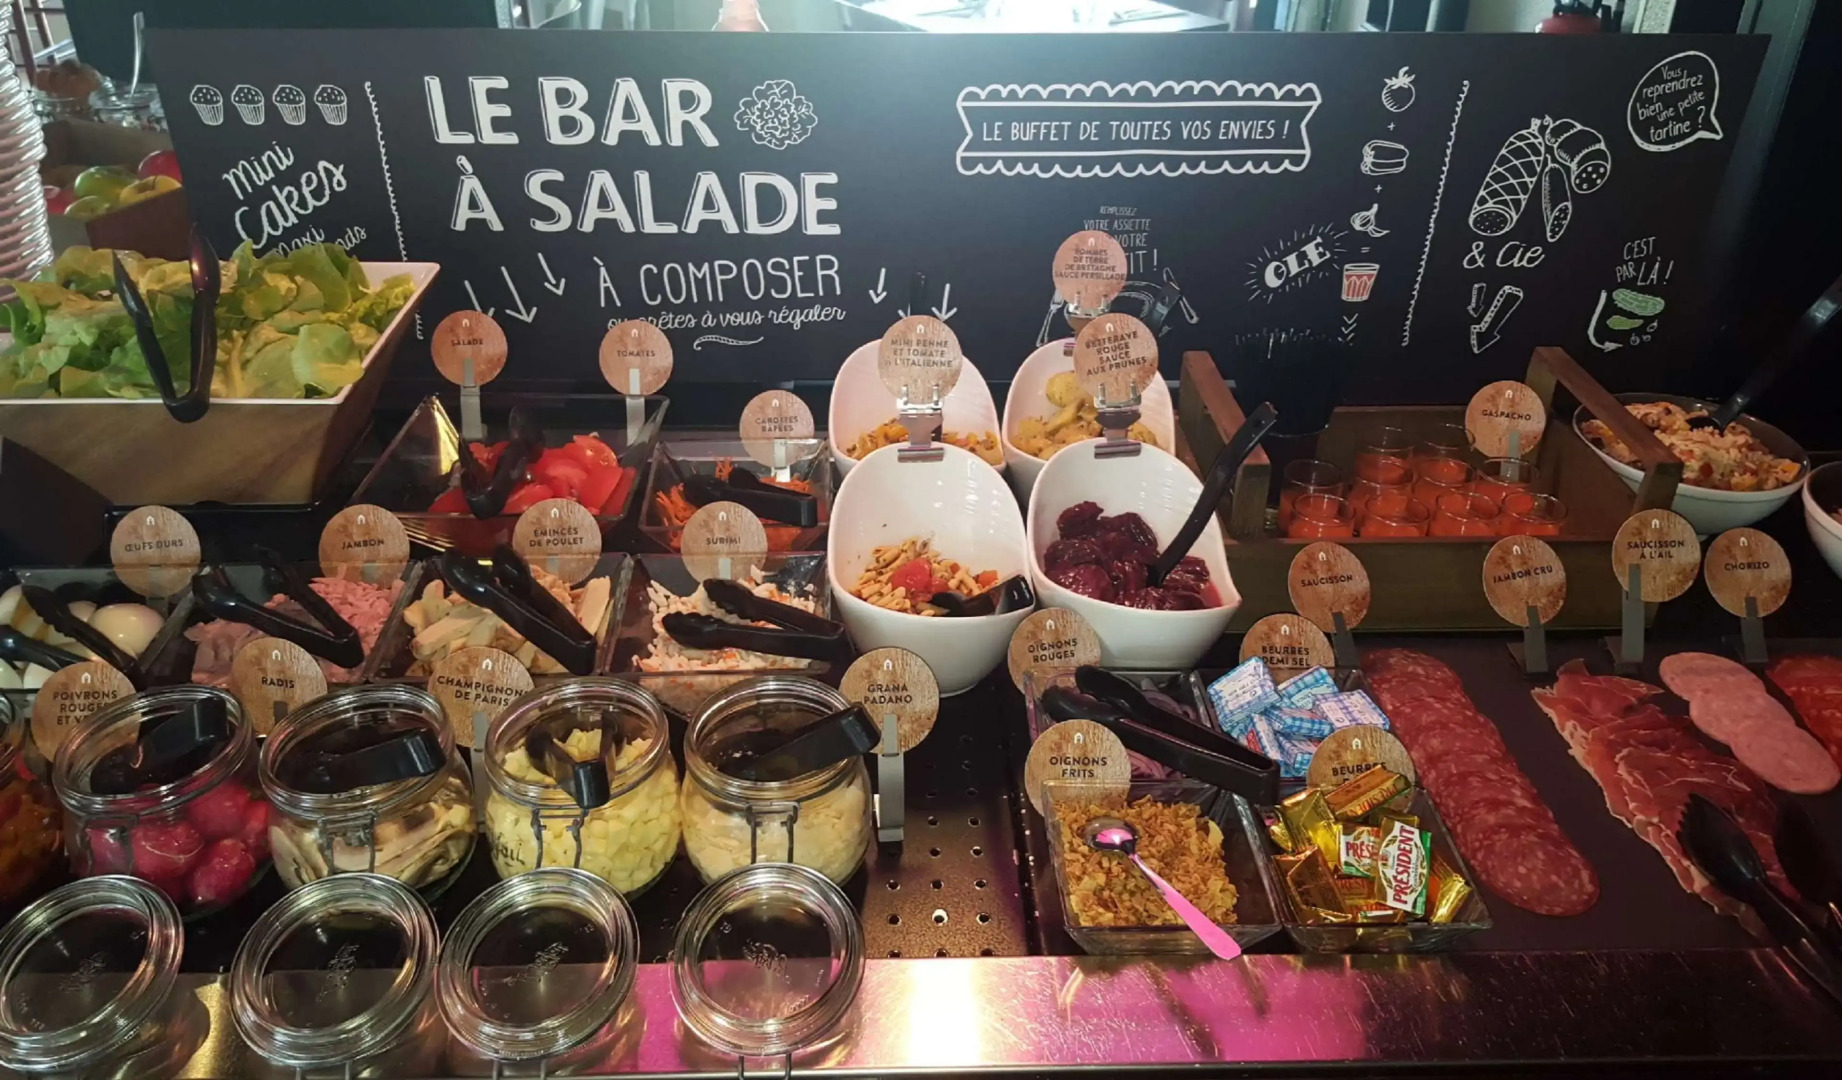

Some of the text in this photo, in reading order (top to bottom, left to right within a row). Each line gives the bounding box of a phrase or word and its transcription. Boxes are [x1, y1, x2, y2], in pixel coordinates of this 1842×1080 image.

[1661, 65, 1682, 80] Vous
[1642, 70, 1703, 103] reprendrez
[424, 75, 720, 147] LE BAR
[1636, 90, 1705, 122] bien une petite
[1649, 105, 1706, 142] tartine ?
[983, 120, 1289, 141] LE BUFFET DE TOUTES VOS ENVIES !
[451, 155, 842, 235] À SALADE
[1083, 218, 1152, 231] VOTRE ASSIETTE
[1462, 240, 1546, 269] & Cie
[1623, 236, 1656, 260] C'EST
[1085, 256, 1109, 264] TERRE
[1077, 264, 1116, 272] BRETAGNE
[1615, 261, 1637, 282] PAR
[593, 255, 842, 307] À COMPOSER
[1055, 271, 1079, 279] SAUCE
[701, 309, 717, 328] à
[719, 310, 764, 327] vous
[767, 304, 847, 331] régaler
[450, 338, 484, 347] SALADE
[890, 339, 949, 348] MINI PENNE
[1085, 331, 1138, 349] BETTERAVE
[617, 350, 656, 358] TOMATES
[893, 349, 946, 358] ET TOMATE
[1096, 342, 1131, 356] ROUGE
[1099, 351, 1131, 365] SAUCE
[1086, 356, 1147, 376] AUX PRUNES
[755, 416, 799, 425] CAROTTES
[1481, 409, 1532, 421] GASPACHO
[156, 539, 184, 548] DURS
[341, 539, 385, 550] JAMBON
[529, 536, 584, 547] DE POULET
[706, 537, 741, 546] SURIMI
[1627, 540, 1685, 549] SAUCISSON
[1649, 551, 1674, 559] L'AIL
[1724, 561, 1770, 571] CHORIZO
[1300, 574, 1353, 588] SAUCISSON
[1493, 565, 1554, 585] JAMBON CRU
[1027, 638, 1078, 654] OIGNONS
[1261, 645, 1310, 656] BEURRES
[1033, 650, 1076, 664] ROUGES
[1263, 656, 1311, 667] DEMI SEL
[261, 676, 296, 689] RADIS
[436, 675, 528, 698] CHAMPIGNON
[867, 683, 909, 693] GRANA
[52, 690, 118, 701] POIVRONS
[454, 690, 509, 707] DE PARIS
[863, 694, 913, 705] PADANO
[56, 715, 71, 725] ET
[1049, 756, 1108, 767] OIGNONS
[1061, 768, 1095, 779] FRITS
[1331, 761, 1387, 777] BEURRS
[1392, 825, 1416, 906] PRÉSIDENT
